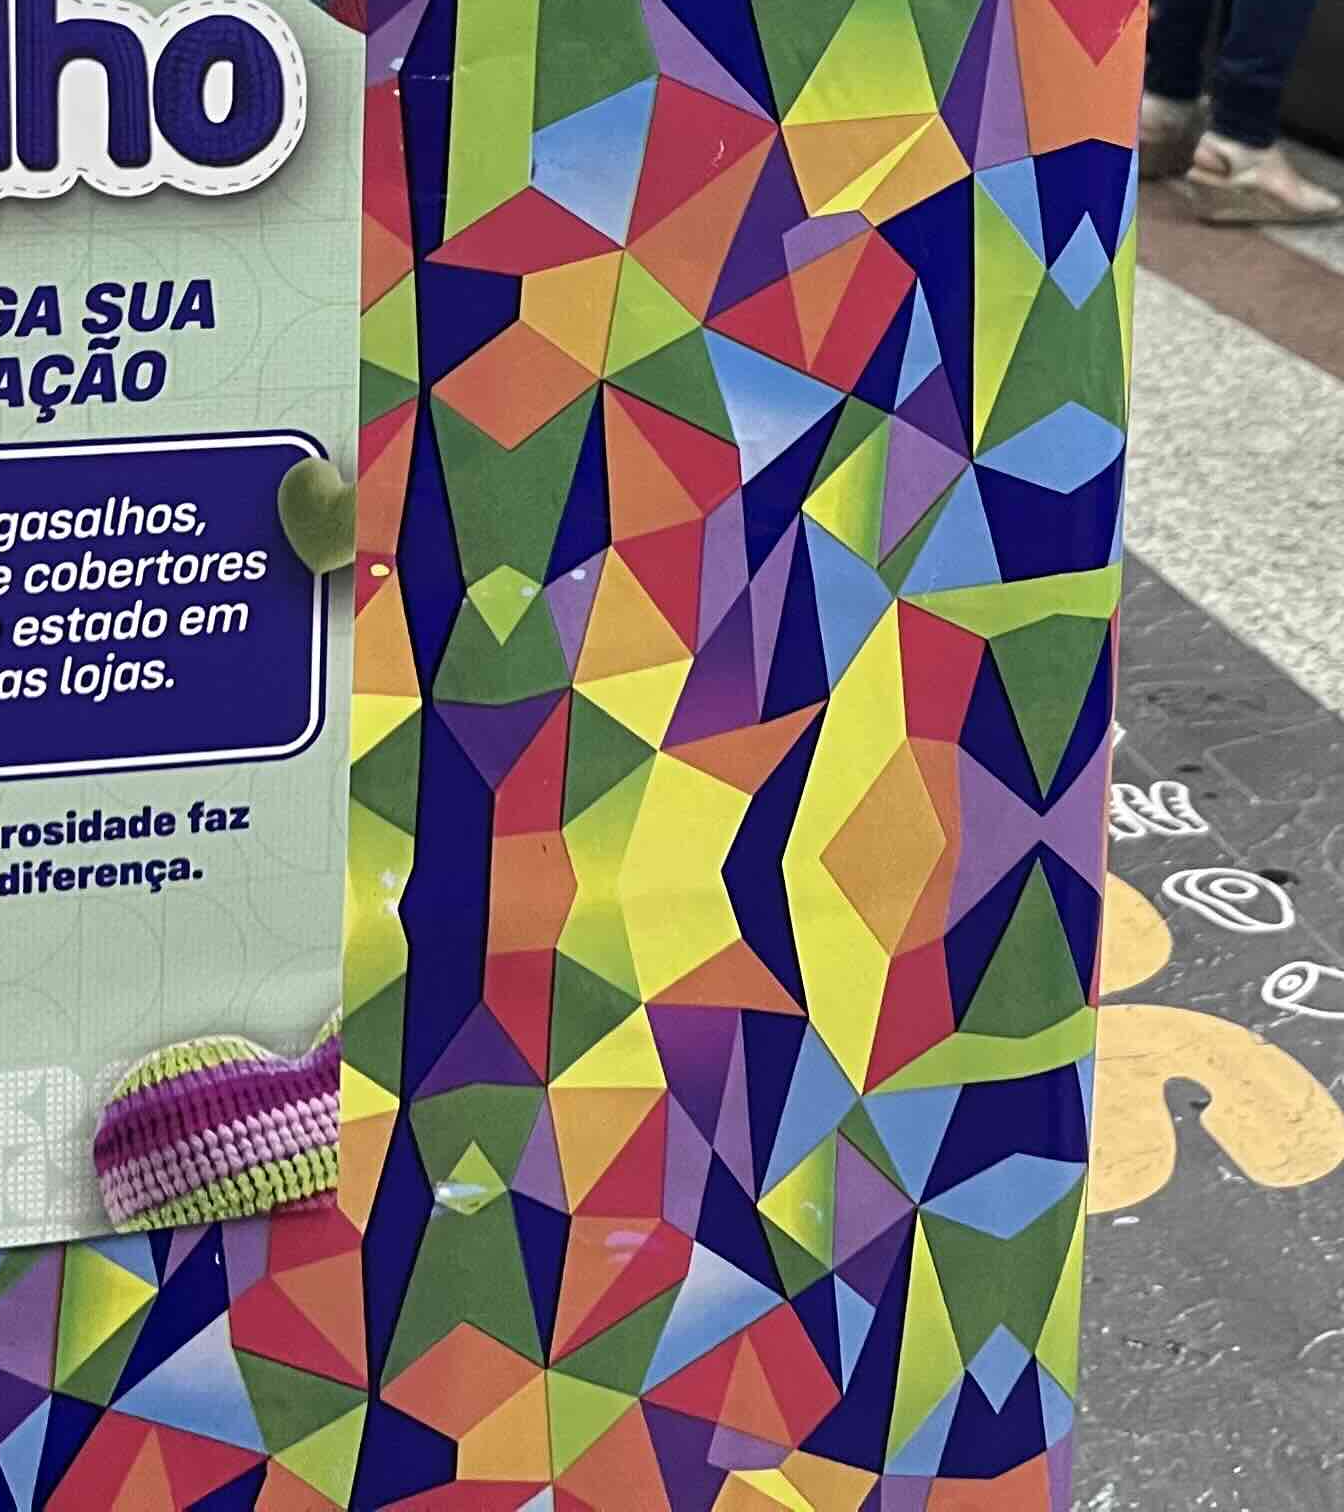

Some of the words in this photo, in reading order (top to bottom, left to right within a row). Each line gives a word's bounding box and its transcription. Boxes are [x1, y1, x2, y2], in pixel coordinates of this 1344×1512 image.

[81, 279, 216, 336] SUA
[23, 548, 268, 592] cobertores
[12, 600, 169, 648] estado
[178, 601, 249, 637] em
[58, 655, 175, 702] lojas.
[187, 801, 250, 833] faz
